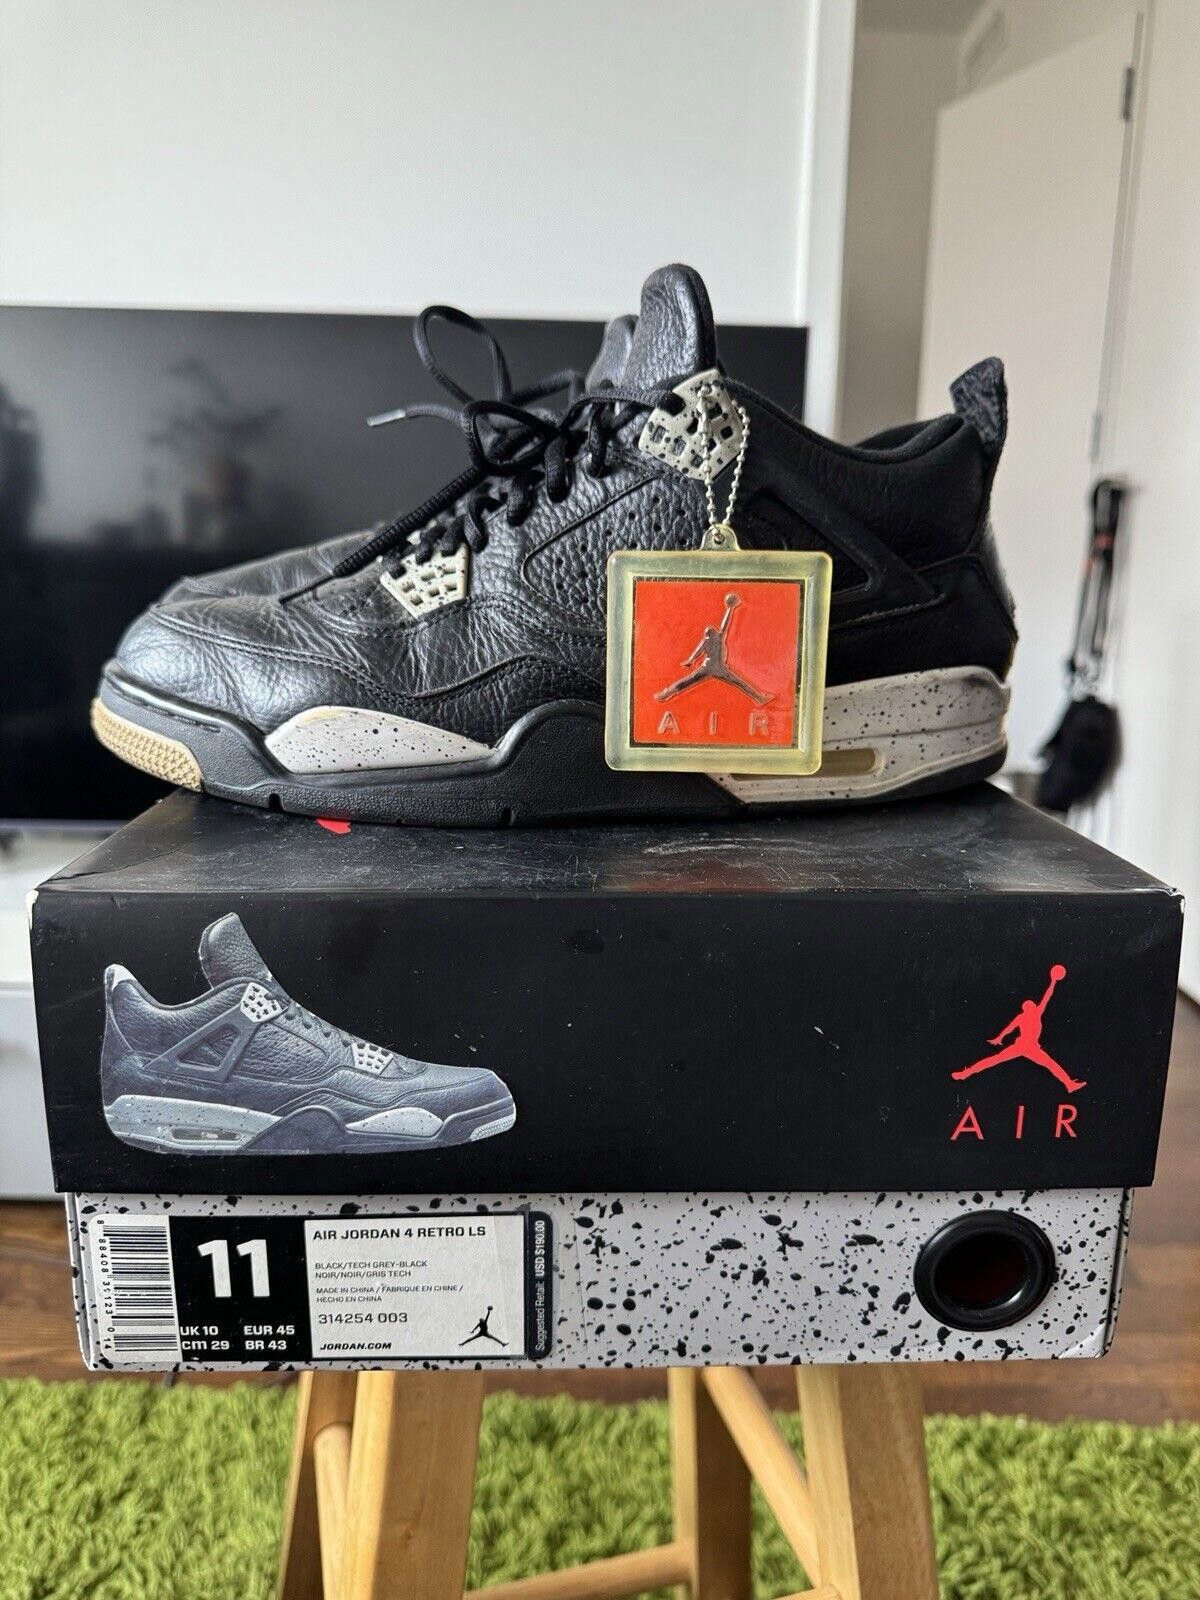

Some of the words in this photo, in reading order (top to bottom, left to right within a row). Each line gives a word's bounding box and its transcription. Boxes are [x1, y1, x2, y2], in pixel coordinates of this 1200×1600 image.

[656, 710, 770, 736] AIR
[950, 1104, 1078, 1141] AIR
[313, 1229, 338, 1240] AIR
[341, 1228, 400, 1240] JORDAN
[404, 1228, 414, 1238] 4
[417, 1226, 465, 1237] RETRO
[468, 1226, 486, 1236] LS
[534, 1219, 545, 1255] $190.00
[197, 1239, 270, 1298] 11
[315, 1261, 371, 1270] BLACK/TECH
[372, 1260, 428, 1268] GREY-BLACK
[534, 1256, 545, 1277] USD
[315, 1271, 386, 1279] NOIR/NOIR/GRIS
[316, 1286, 338, 1294] MADE
[381, 1285, 419, 1293] FABRIQUE
[433, 1284, 458, 1292] CHINE
[316, 1296, 344, 1304] HECHO
[318, 1313, 374, 1324] 314254
[378, 1312, 408, 1323] 003
[180, 1325, 200, 1336] UK
[202, 1325, 219, 1336] 10
[243, 1324, 273, 1336] EUR
[276, 1325, 296, 1335] 45
[535, 1309, 547, 1351] Suggested
[211, 1340, 230, 1350] 29
[245, 1340, 265, 1350] BR
[267, 1340, 287, 1350] 43
[320, 1342, 392, 1350] JORDAN.COM
